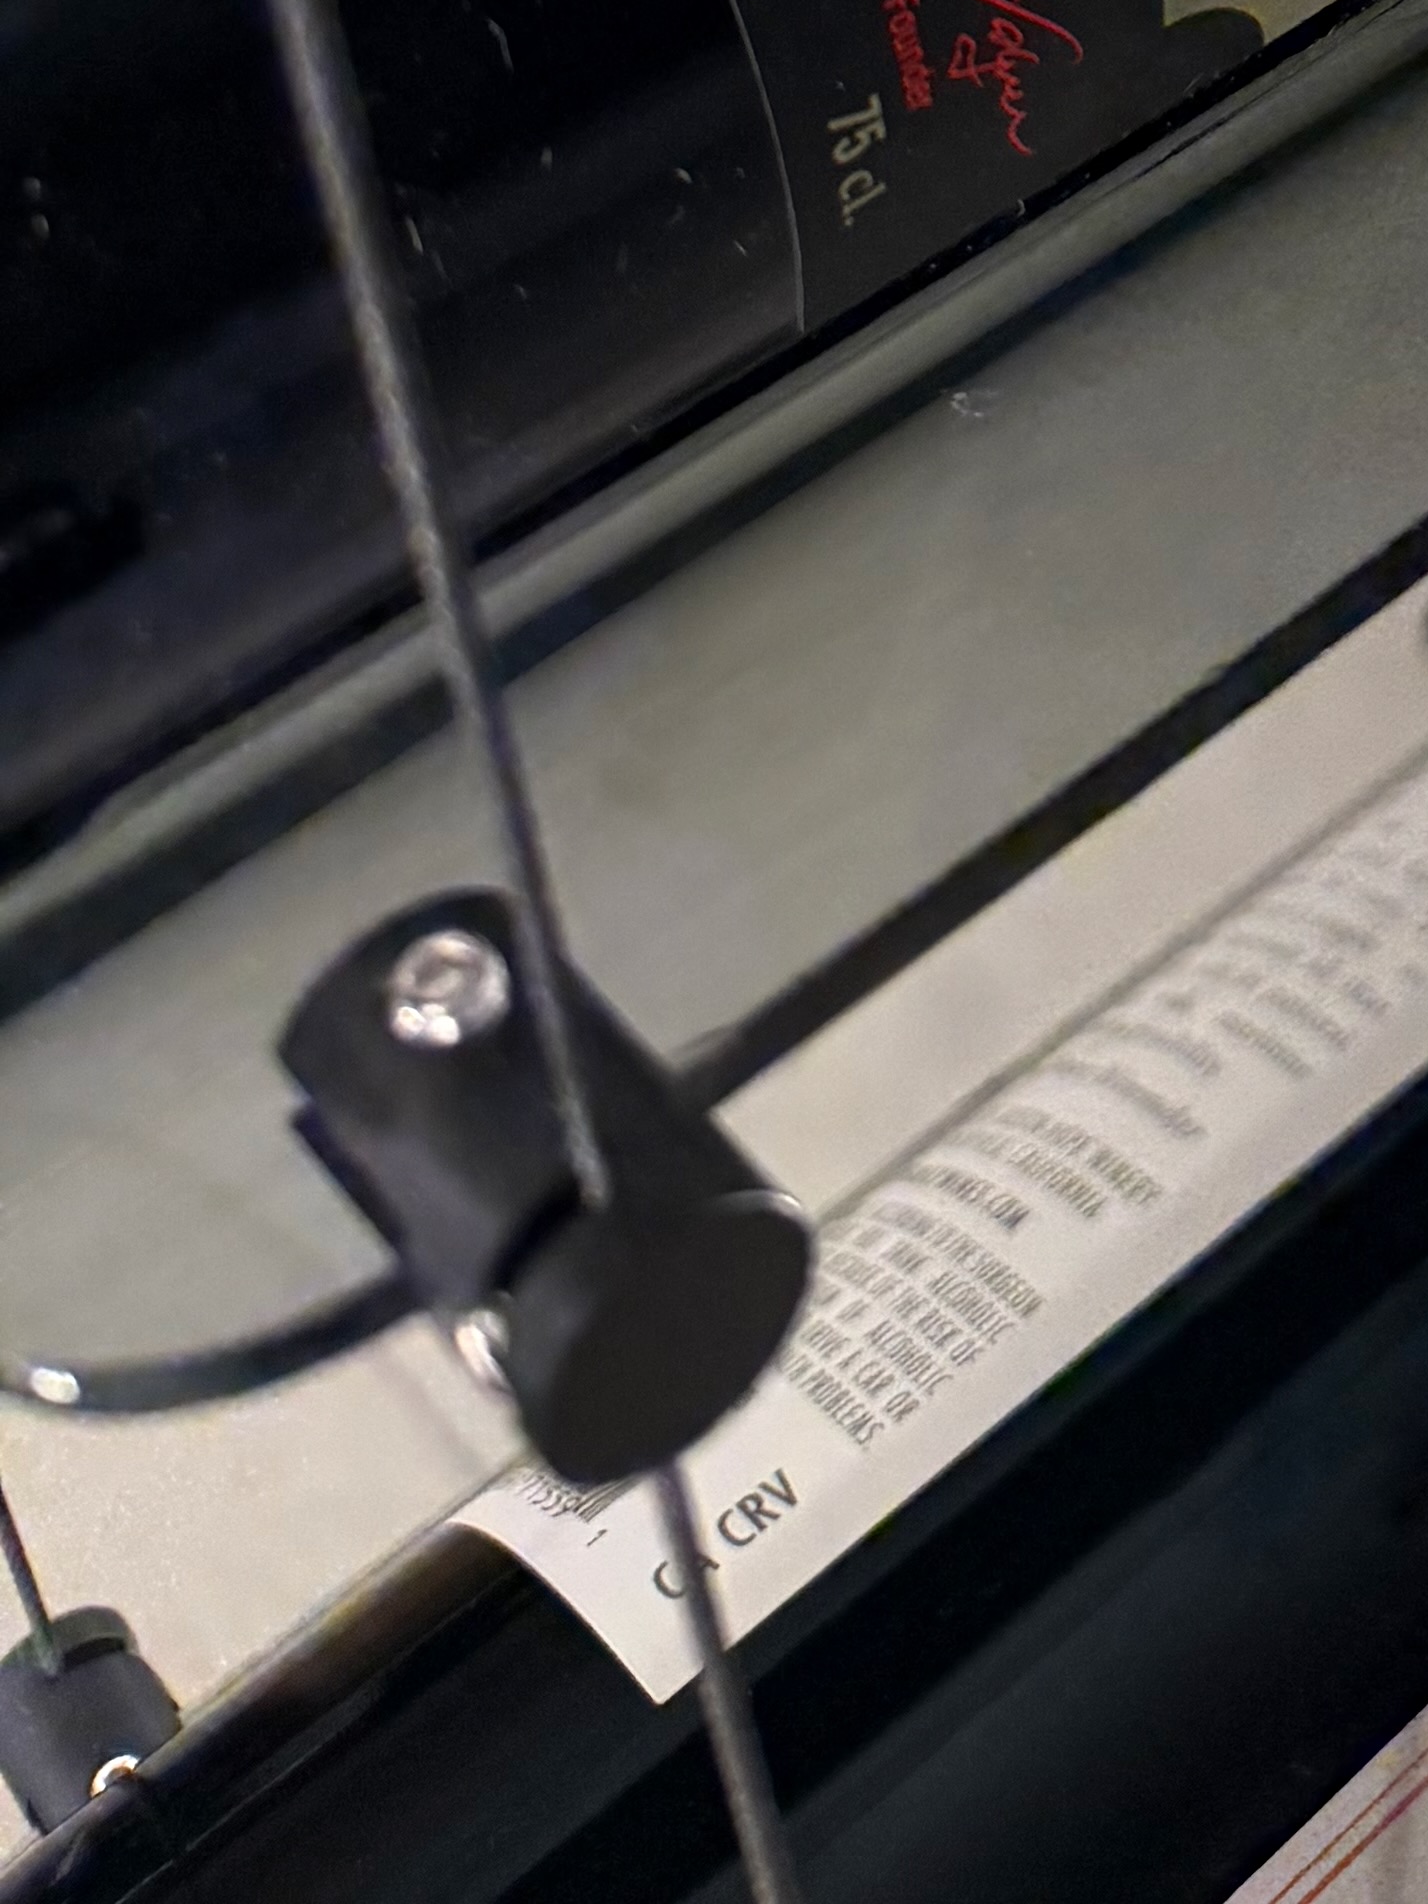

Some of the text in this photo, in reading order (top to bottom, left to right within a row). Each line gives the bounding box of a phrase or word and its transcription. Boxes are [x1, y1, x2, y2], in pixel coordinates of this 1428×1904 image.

[826, 93, 887, 166] 75
[851, 1360, 896, 1398] CAR
[884, 1390, 921, 1424] OR
[862, 1319, 954, 1396] ALCOHOLIC
[716, 1467, 798, 1548] CRV
